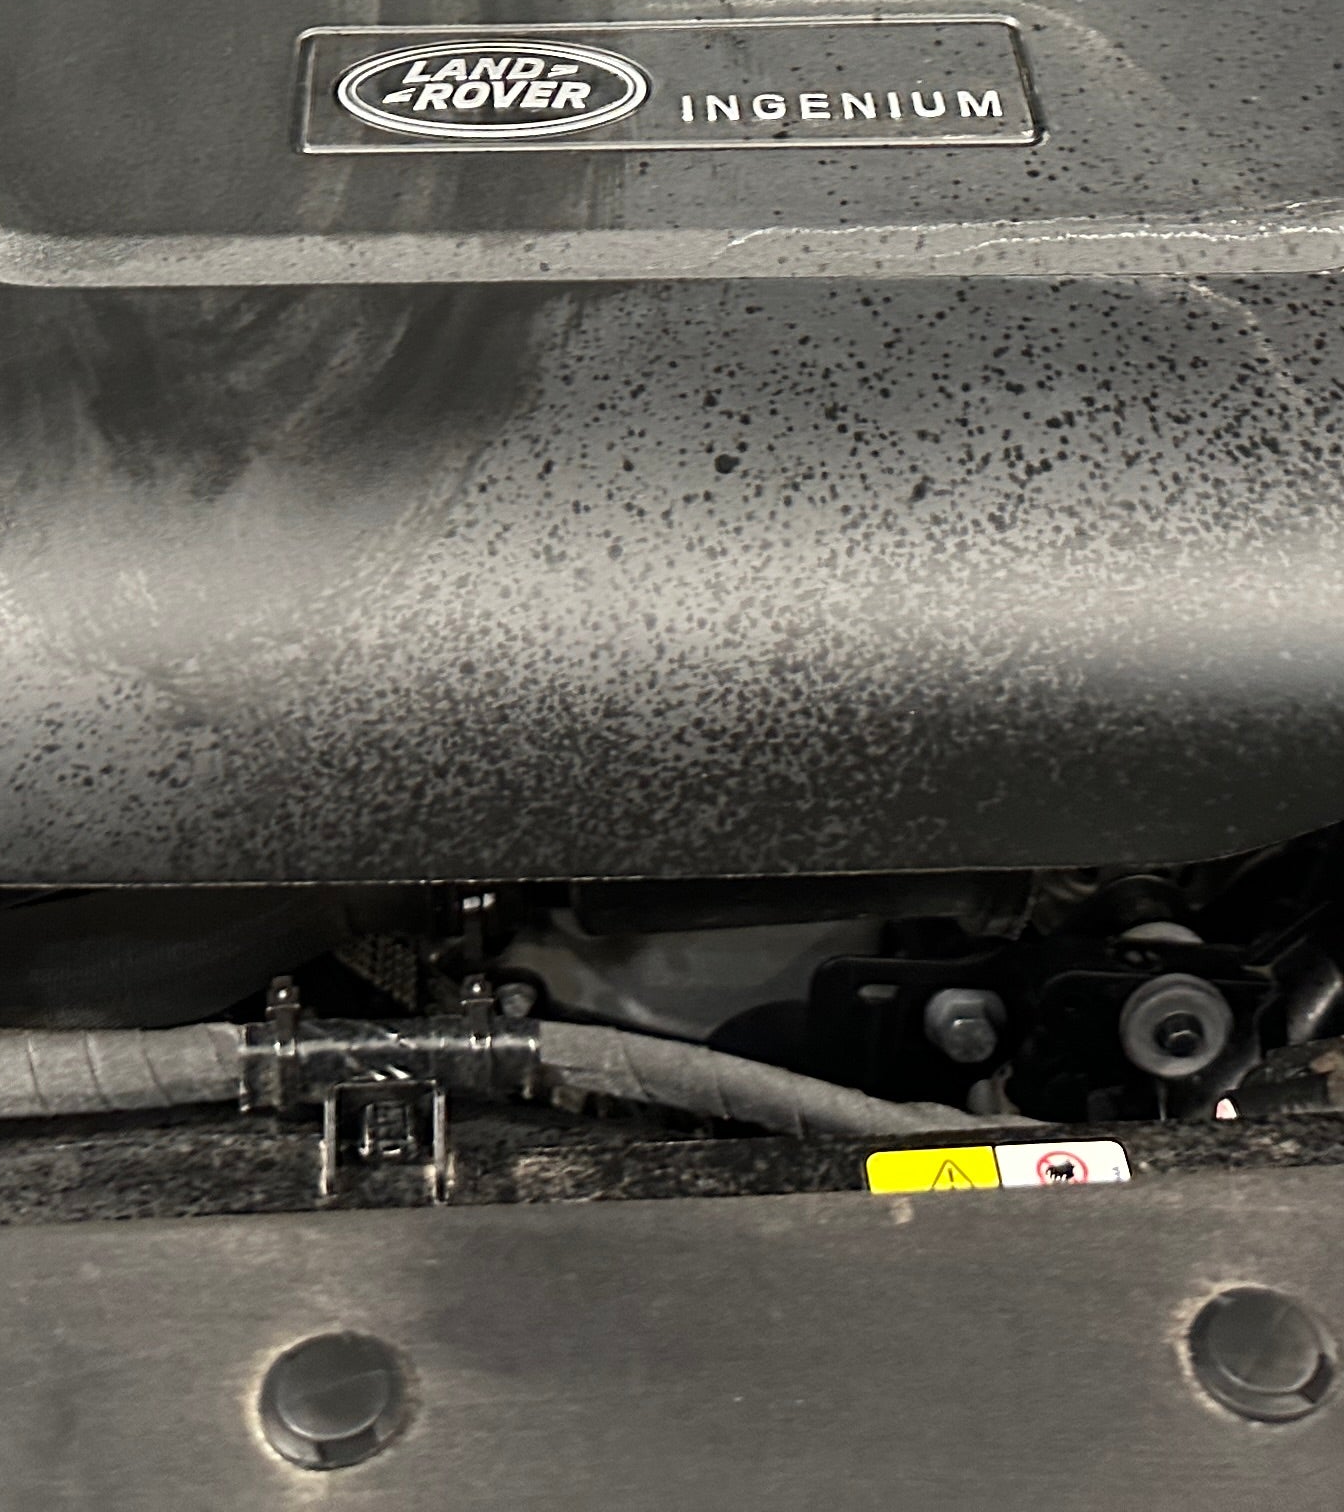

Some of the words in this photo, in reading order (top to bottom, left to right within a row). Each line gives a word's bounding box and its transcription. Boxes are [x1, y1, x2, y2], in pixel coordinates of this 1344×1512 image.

[403, 57, 546, 84] LAND
[412, 80, 591, 111] ROVER
[680, 90, 1003, 122] INGENIUM
